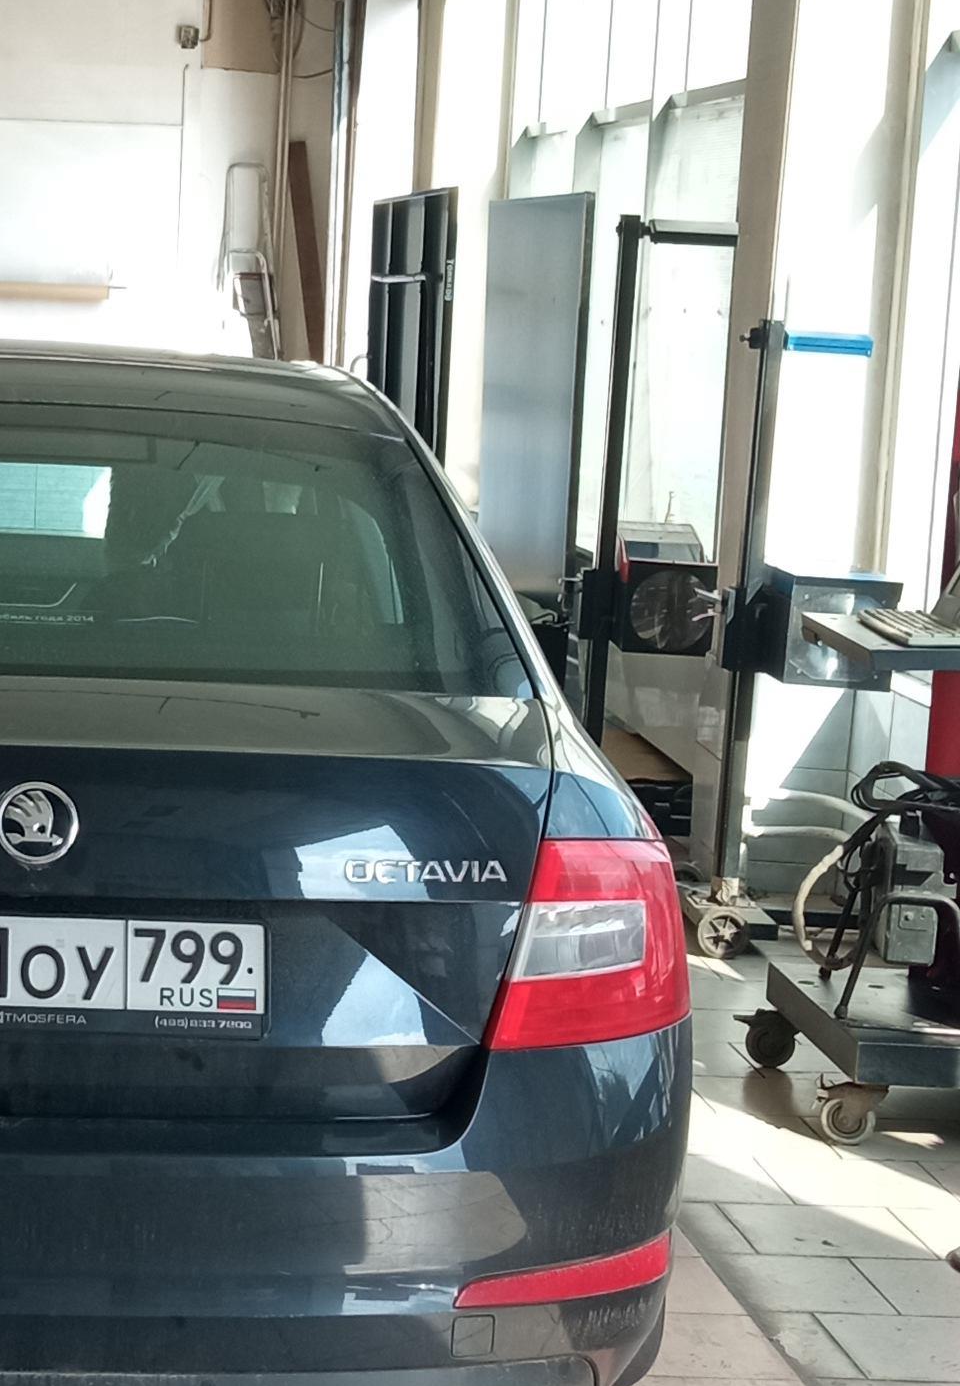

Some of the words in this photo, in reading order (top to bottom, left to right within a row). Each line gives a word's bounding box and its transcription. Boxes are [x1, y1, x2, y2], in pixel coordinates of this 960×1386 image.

[345, 859, 507, 883] OCTAVIA
[133, 928, 243, 985] 799
[160, 987, 214, 1007] RUS
